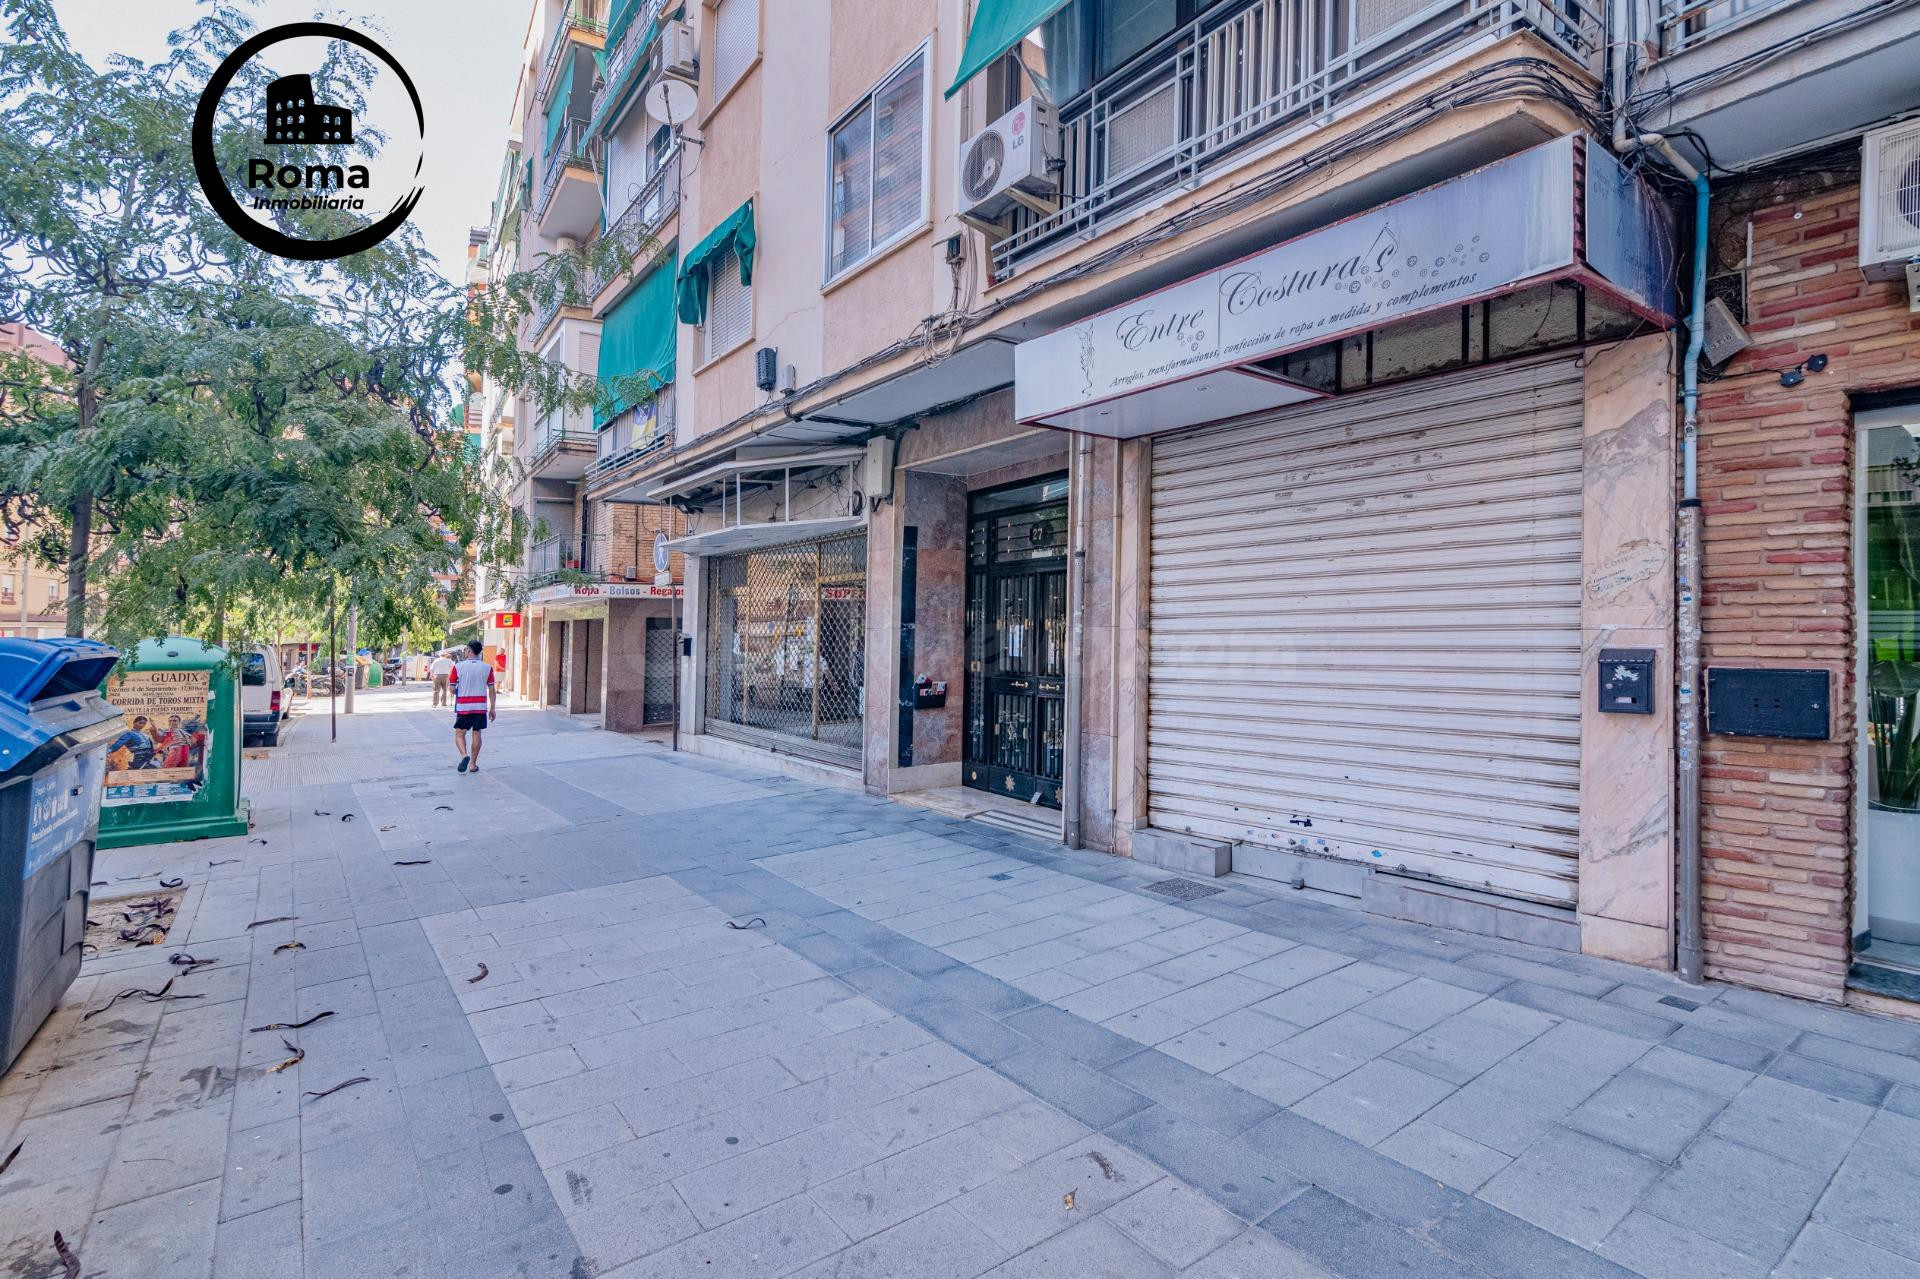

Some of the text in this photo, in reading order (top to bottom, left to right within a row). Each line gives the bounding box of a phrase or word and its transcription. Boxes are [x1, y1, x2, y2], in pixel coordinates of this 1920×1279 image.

[1012, 135, 1025, 150] LG
[1109, 272, 1478, 388] Arreglos, transformaciones, confección de ropa a medida y complementos
[1116, 309, 1204, 351] Entre
[1032, 528, 1043, 541] 27
[575, 586, 599, 597] Ropa
[609, 586, 640, 595] Bolsos
[650, 586, 684, 597] Regaos
[151, 673, 199, 683] GUADIX
[147, 697, 157, 705] DE
[183, 696, 205, 704] MIXTA
